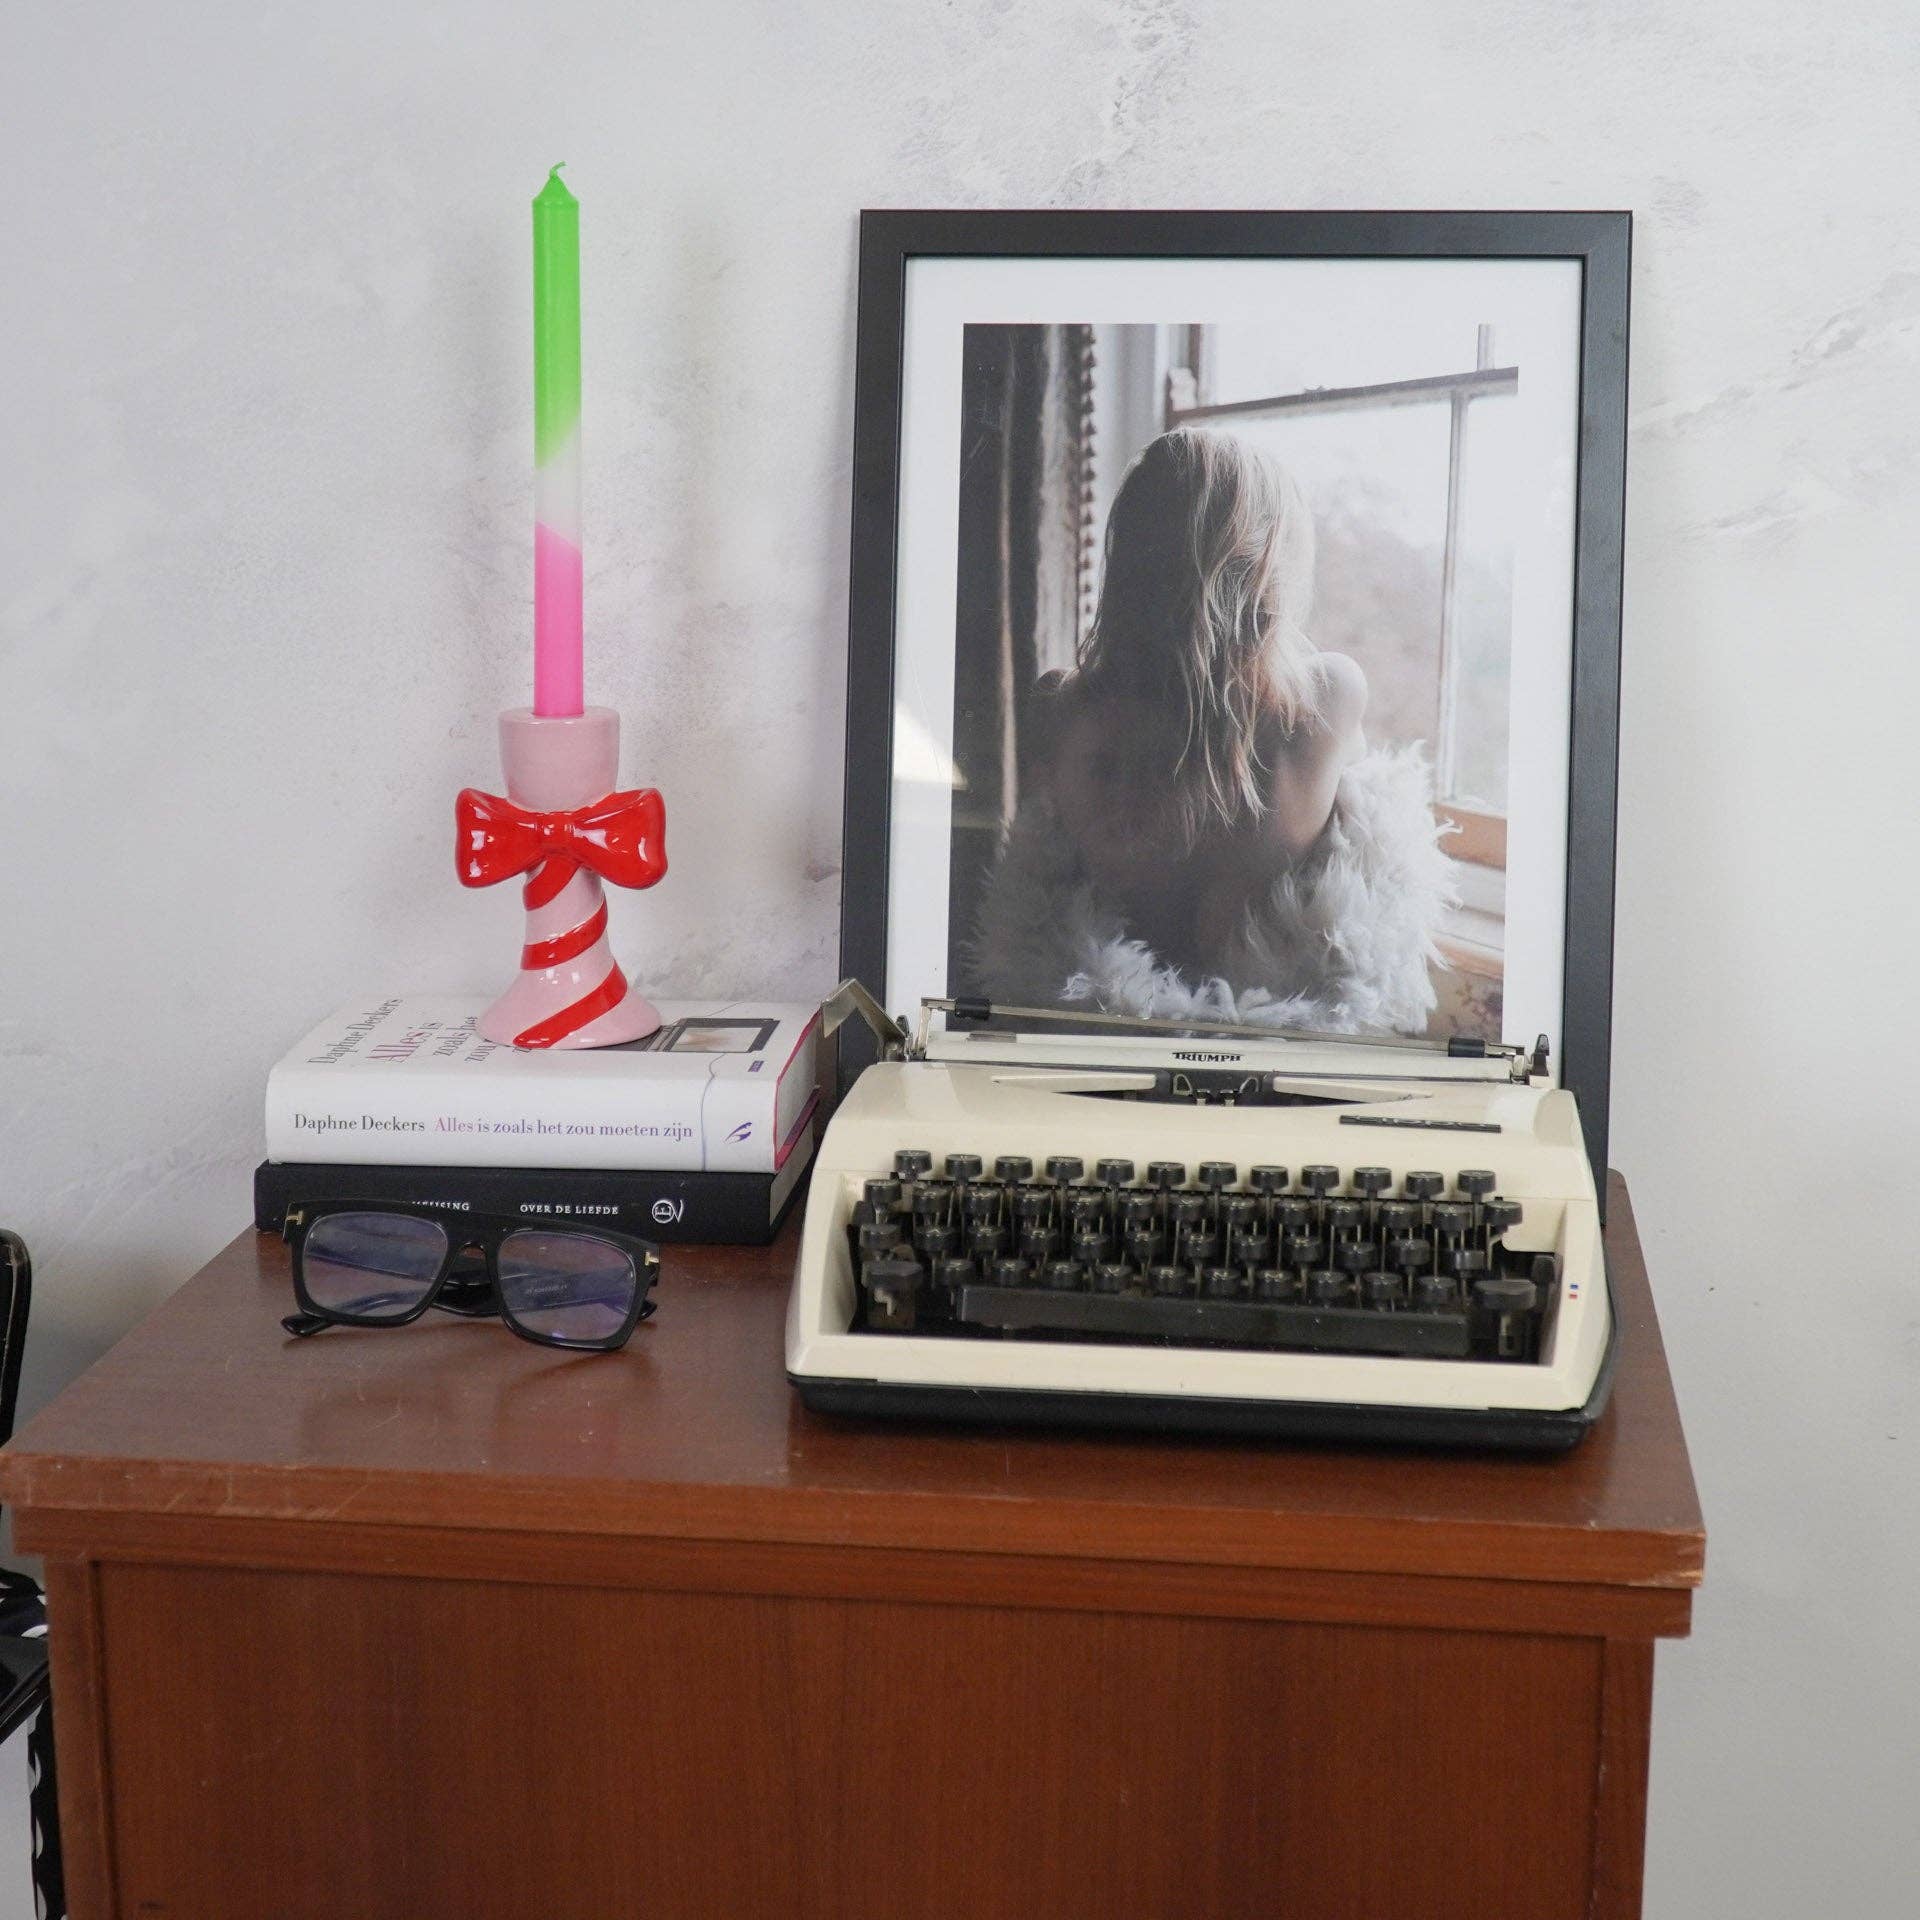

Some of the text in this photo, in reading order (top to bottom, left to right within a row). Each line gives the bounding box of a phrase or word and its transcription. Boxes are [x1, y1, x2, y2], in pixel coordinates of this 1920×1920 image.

[308, 999, 403, 1063] Daphne Deckers
[366, 1031, 432, 1063] Alles
[1172, 1051, 1243, 1062] TRIUMPH
[294, 1114, 693, 1141] Daphne Deckers Alles is zoals het zou moeten zijn
[520, 1204, 550, 1213] OVER
[555, 1204, 571, 1214] DE
[575, 1205, 619, 1215] LIEFDE
